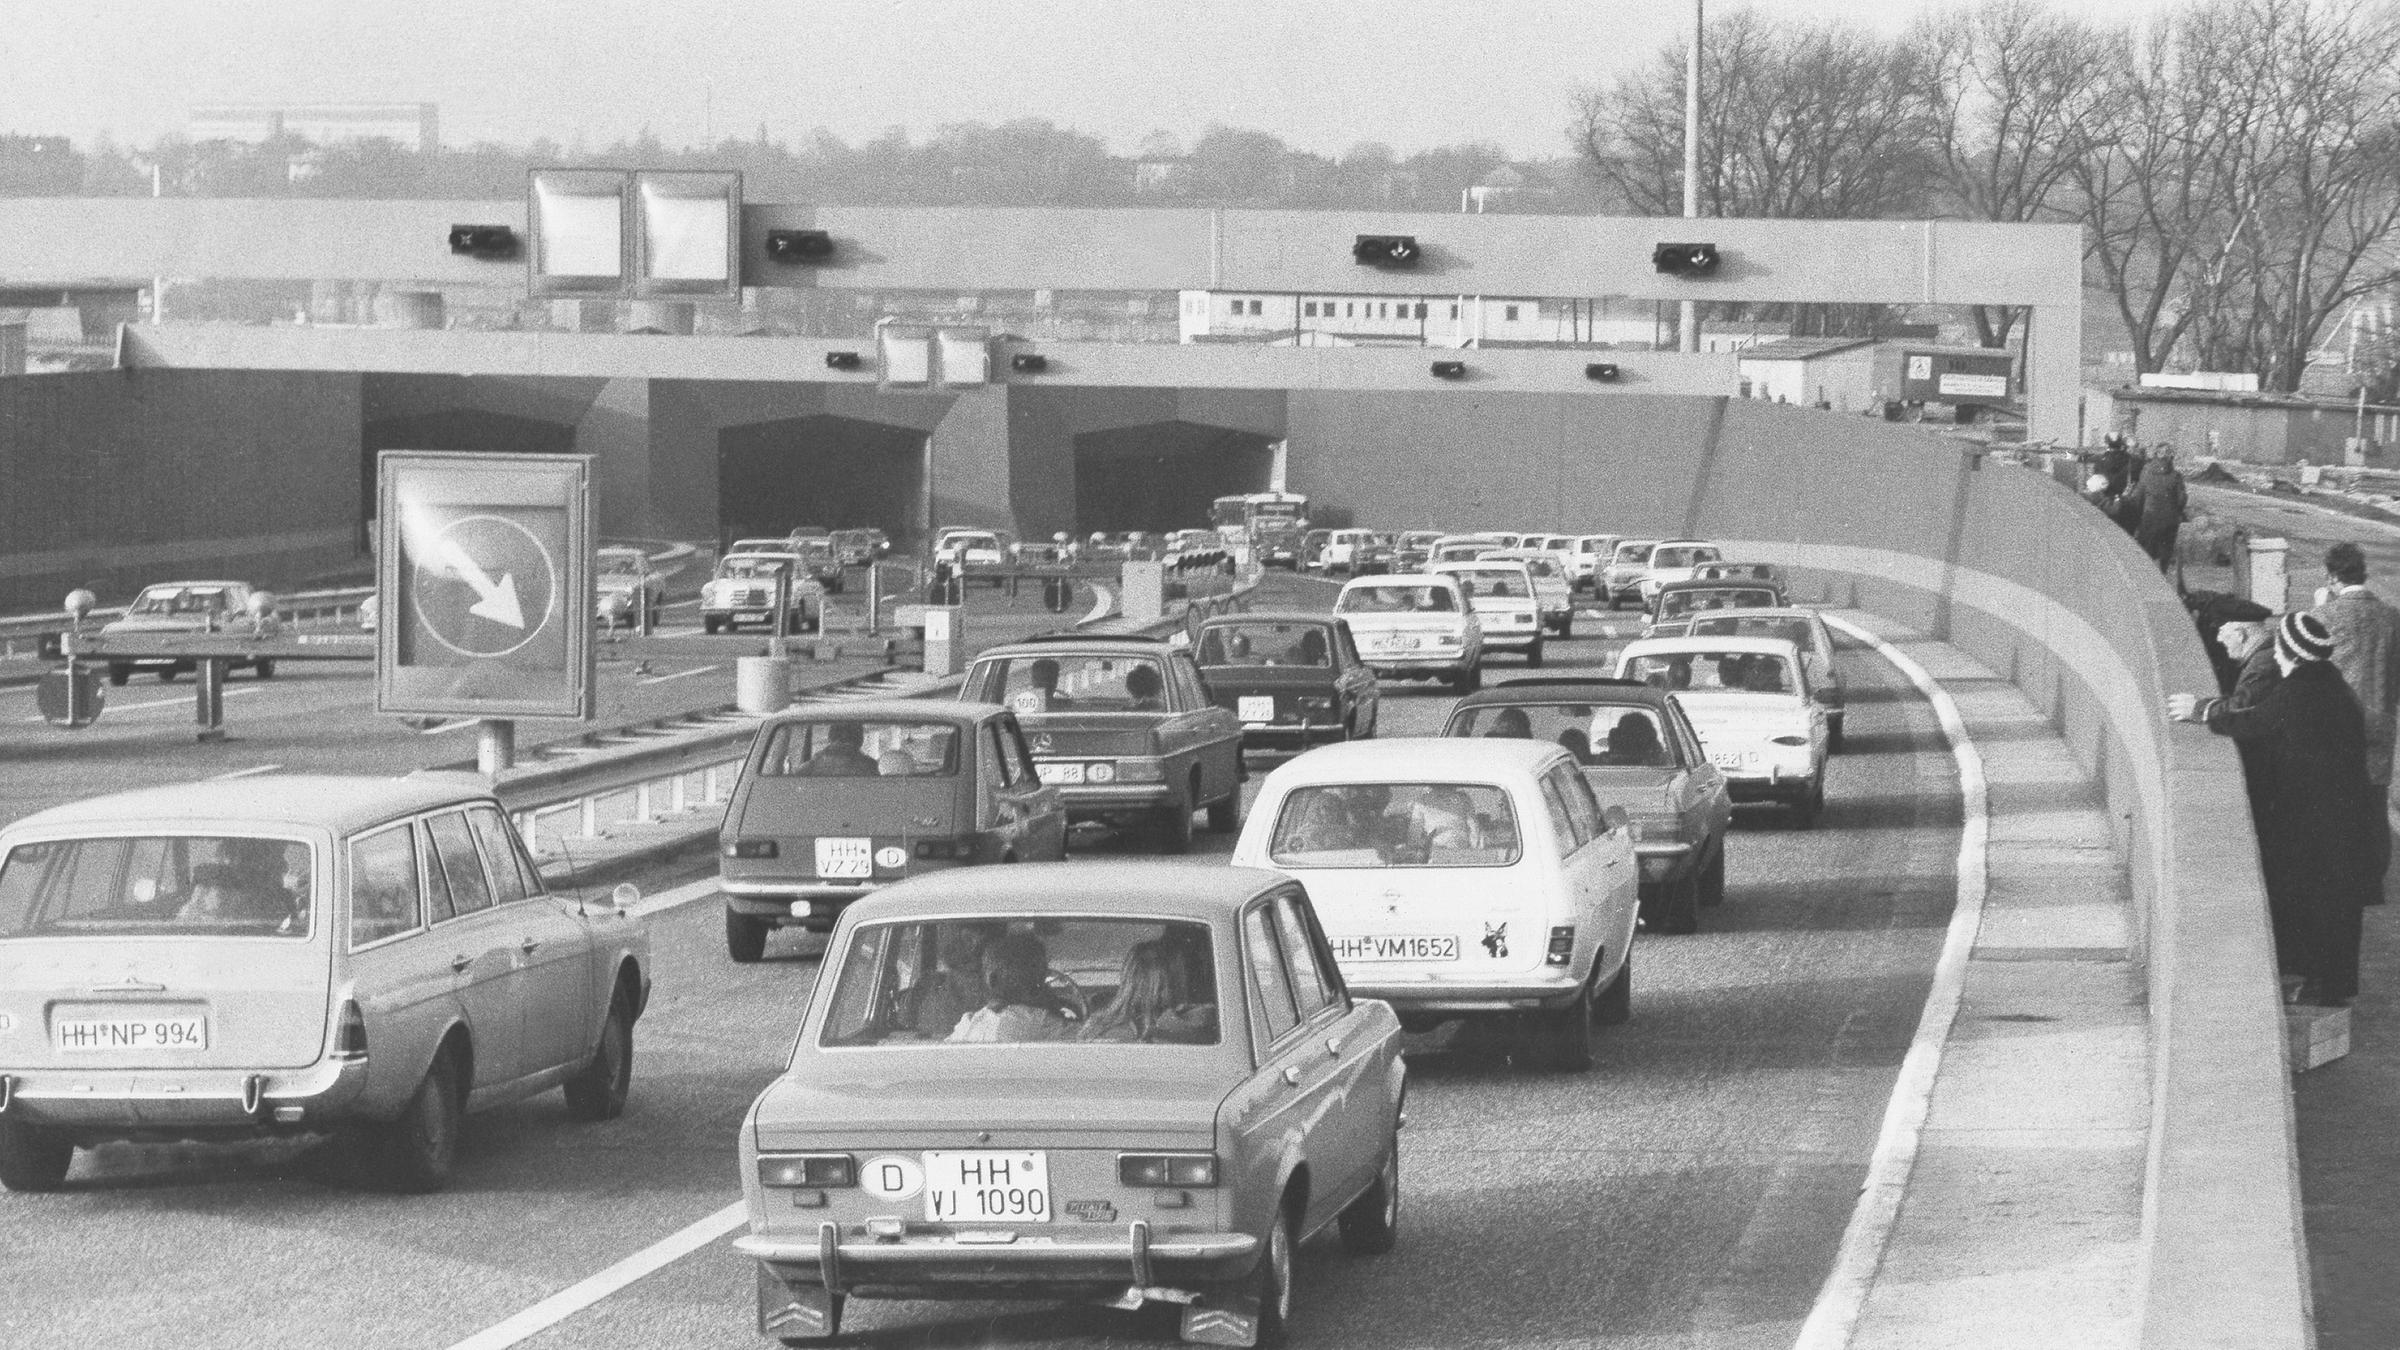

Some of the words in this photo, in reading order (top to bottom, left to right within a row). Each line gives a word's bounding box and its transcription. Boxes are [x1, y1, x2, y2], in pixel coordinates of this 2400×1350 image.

[1096, 766, 1106, 779] D
[830, 843, 857, 857] HH
[886, 849, 900, 865] D
[820, 860, 844, 873] VZ
[62, 1023, 98, 1046] HH
[111, 1023, 147, 1046] NP
[154, 1021, 199, 1045] 994
[881, 1164, 904, 1192] D
[960, 1158, 1011, 1185] HH
[931, 1190, 957, 1216] VJ
[976, 1188, 1044, 1215] 1090
